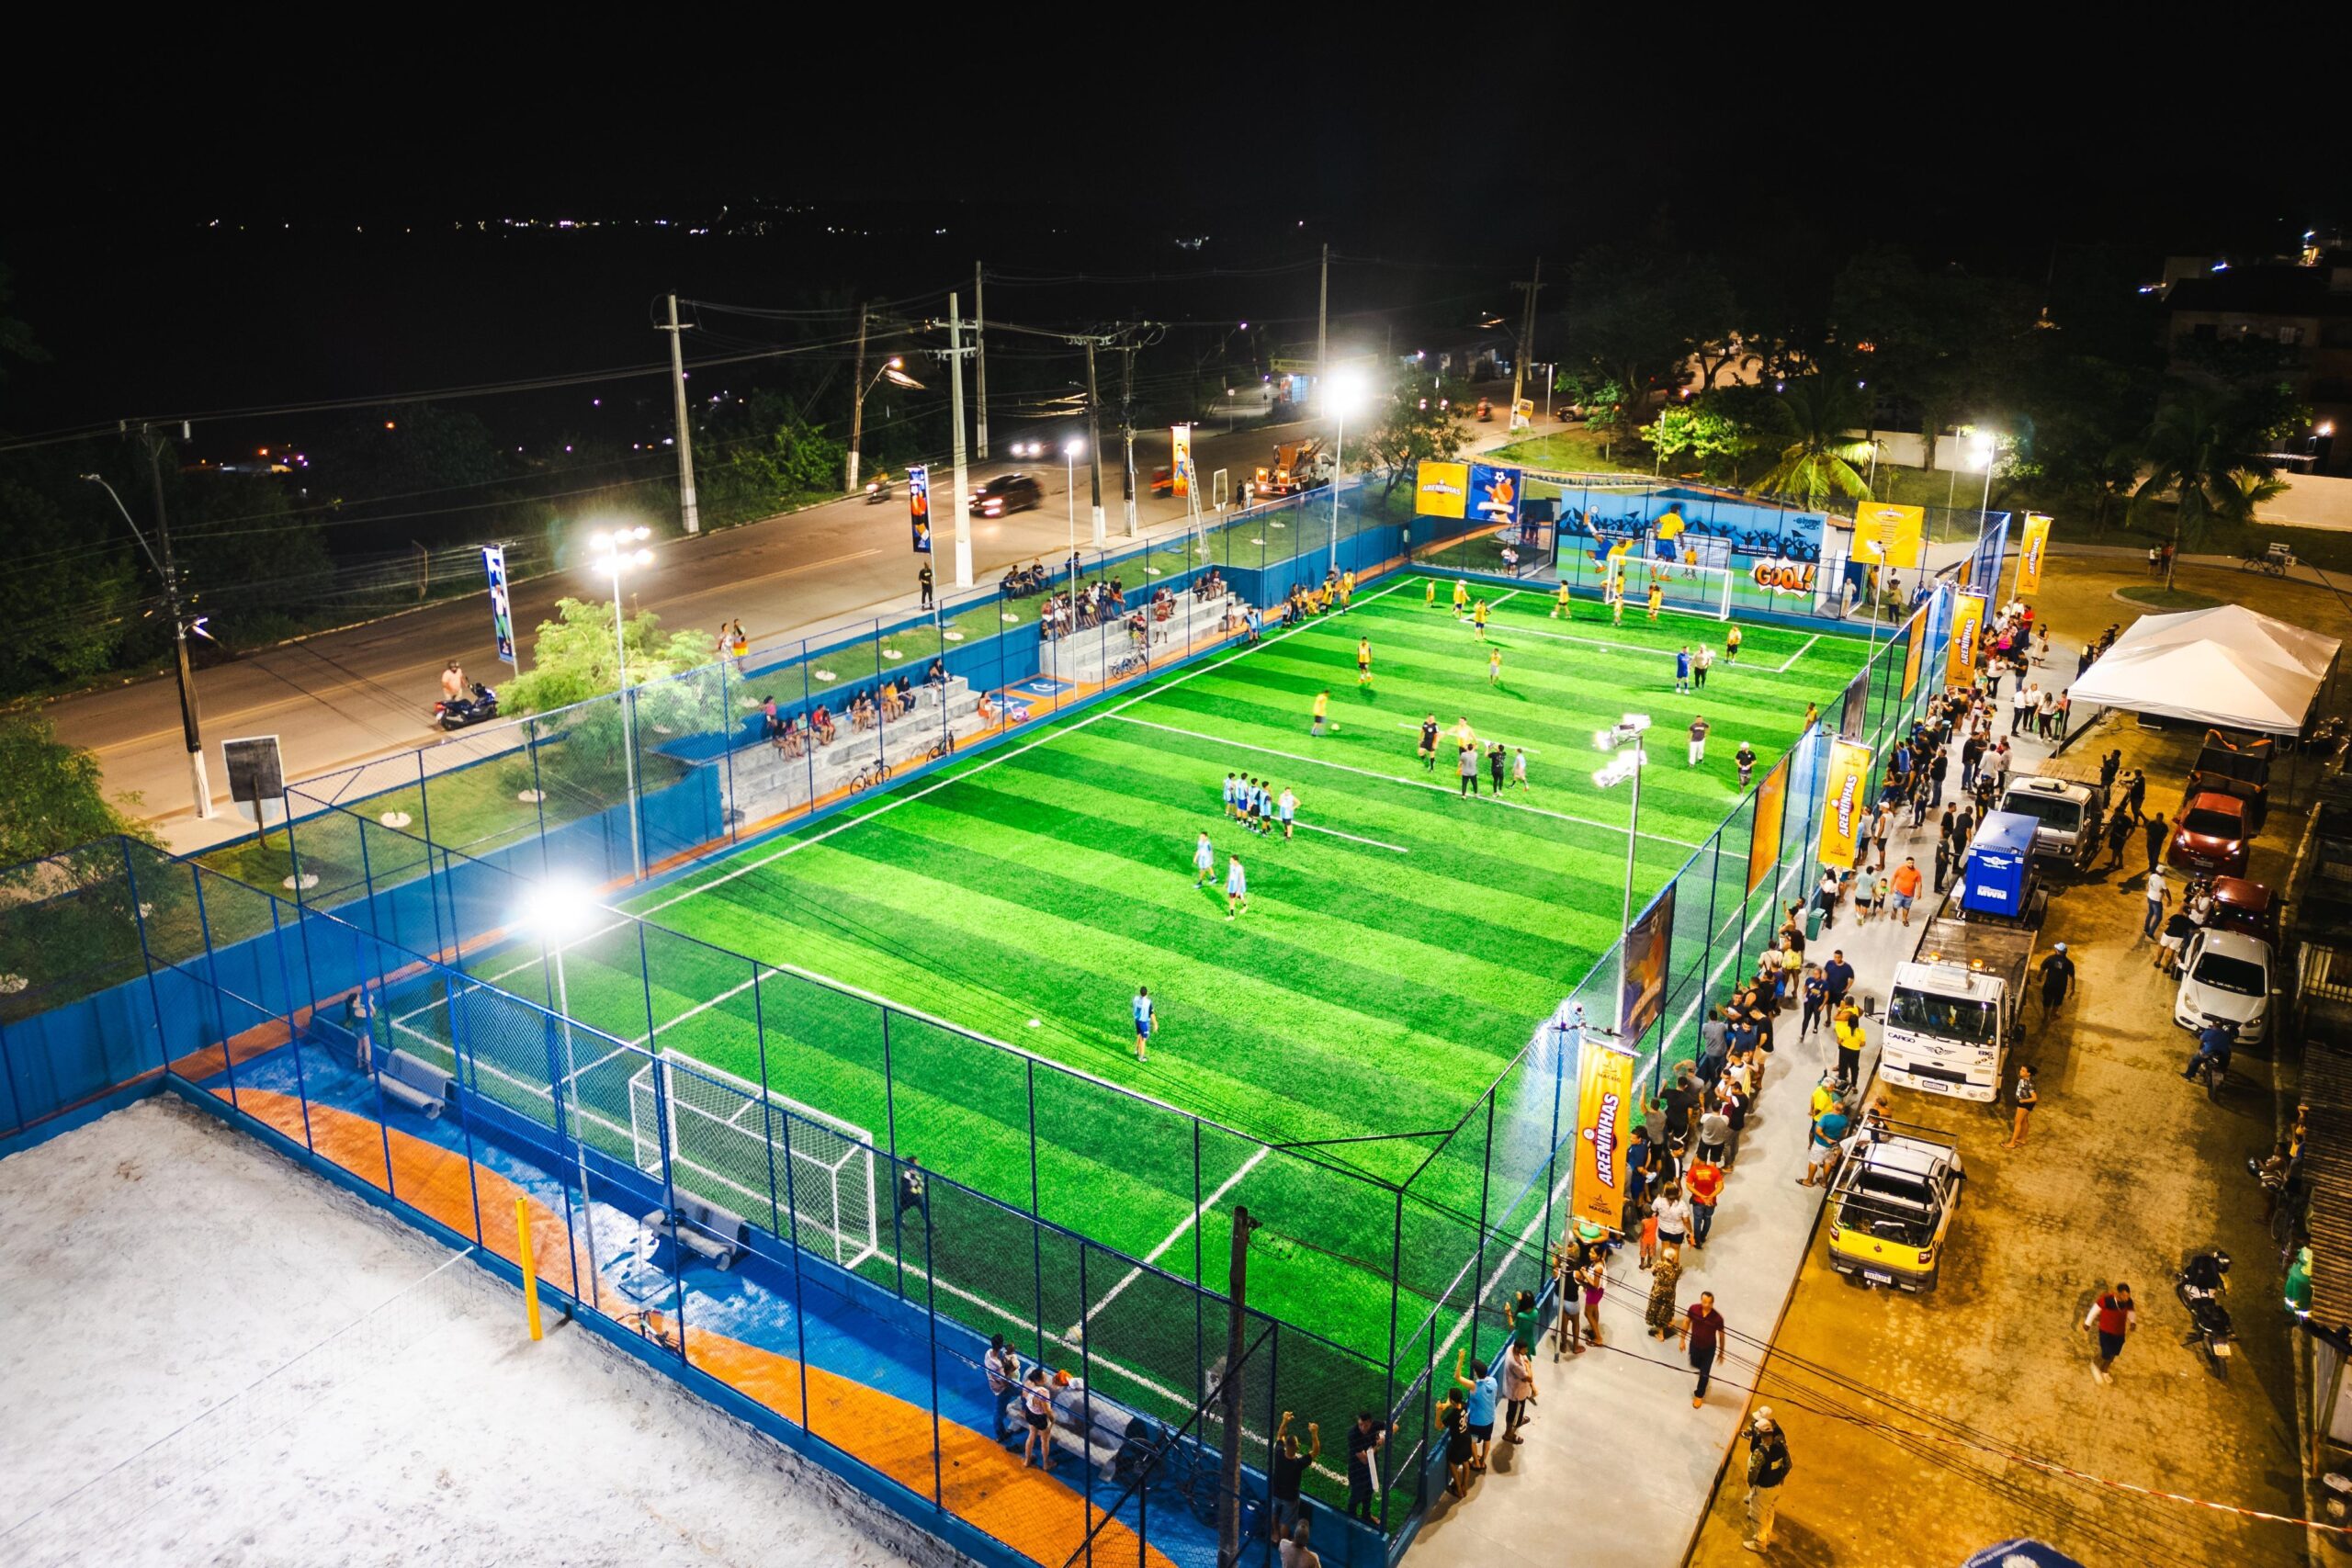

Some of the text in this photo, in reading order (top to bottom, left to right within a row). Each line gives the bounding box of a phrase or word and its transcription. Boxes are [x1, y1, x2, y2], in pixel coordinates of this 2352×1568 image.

[1422, 483, 1462, 495] ARENINHAS
[1755, 563, 1816, 592] GOOL!
[1961, 618, 1976, 666] ARENINHAS
[1838, 774, 1858, 839] ARENINHAS
[1888, 1032, 1916, 1043] CARGO
[1596, 1092, 1620, 1188] ARENINHAS
